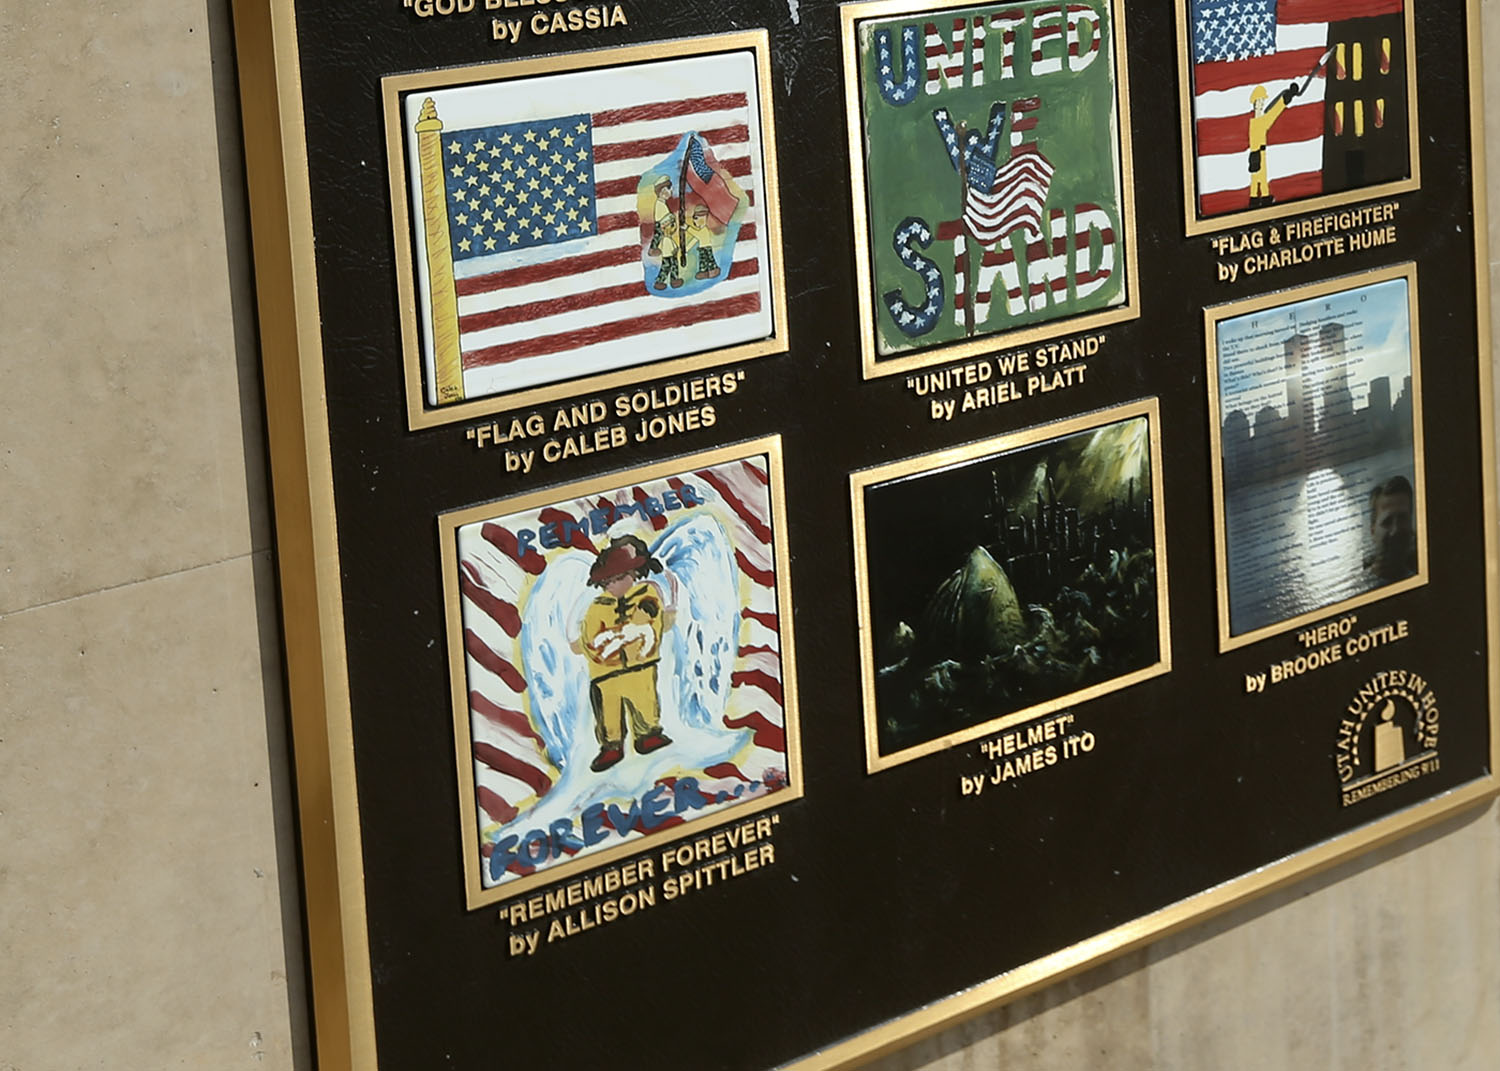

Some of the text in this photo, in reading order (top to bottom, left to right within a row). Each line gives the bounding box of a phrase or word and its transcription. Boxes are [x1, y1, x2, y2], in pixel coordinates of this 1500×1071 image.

[492, 6, 627, 44] by CASSIA
[874, 4, 1101, 107] UNITED
[933, 97, 1042, 173] WE
[1212, 204, 1399, 255] "FLAG & FIREFIGHTER"
[1218, 227, 1396, 283] by CHARLOTTE HUME
[882, 203, 1116, 338] STAND
[906, 337, 1106, 397] "UNITED WE STAND"
[931, 364, 1088, 422] by ARIEL PLATT
[466, 371, 745, 448] "FLAG AND SOLDIERS"
[505, 406, 717, 473] by CALEB JONES
[515, 481, 707, 557] REMEMBER
[1245, 620, 1409, 694] by BROOKE COTTLE
[1298, 617, 1357, 649] "HERO"
[981, 714, 1074, 760] "HELMET"
[1336, 670, 1439, 782] UTAH UNITES IN HOPE
[961, 732, 1095, 796] by JAMES ITO
[1342, 766, 1420, 807] REMEMBERING
[499, 815, 780, 927] "REMEMBER FOREVER"
[509, 843, 776, 958] by ALLISON SPITTLER
